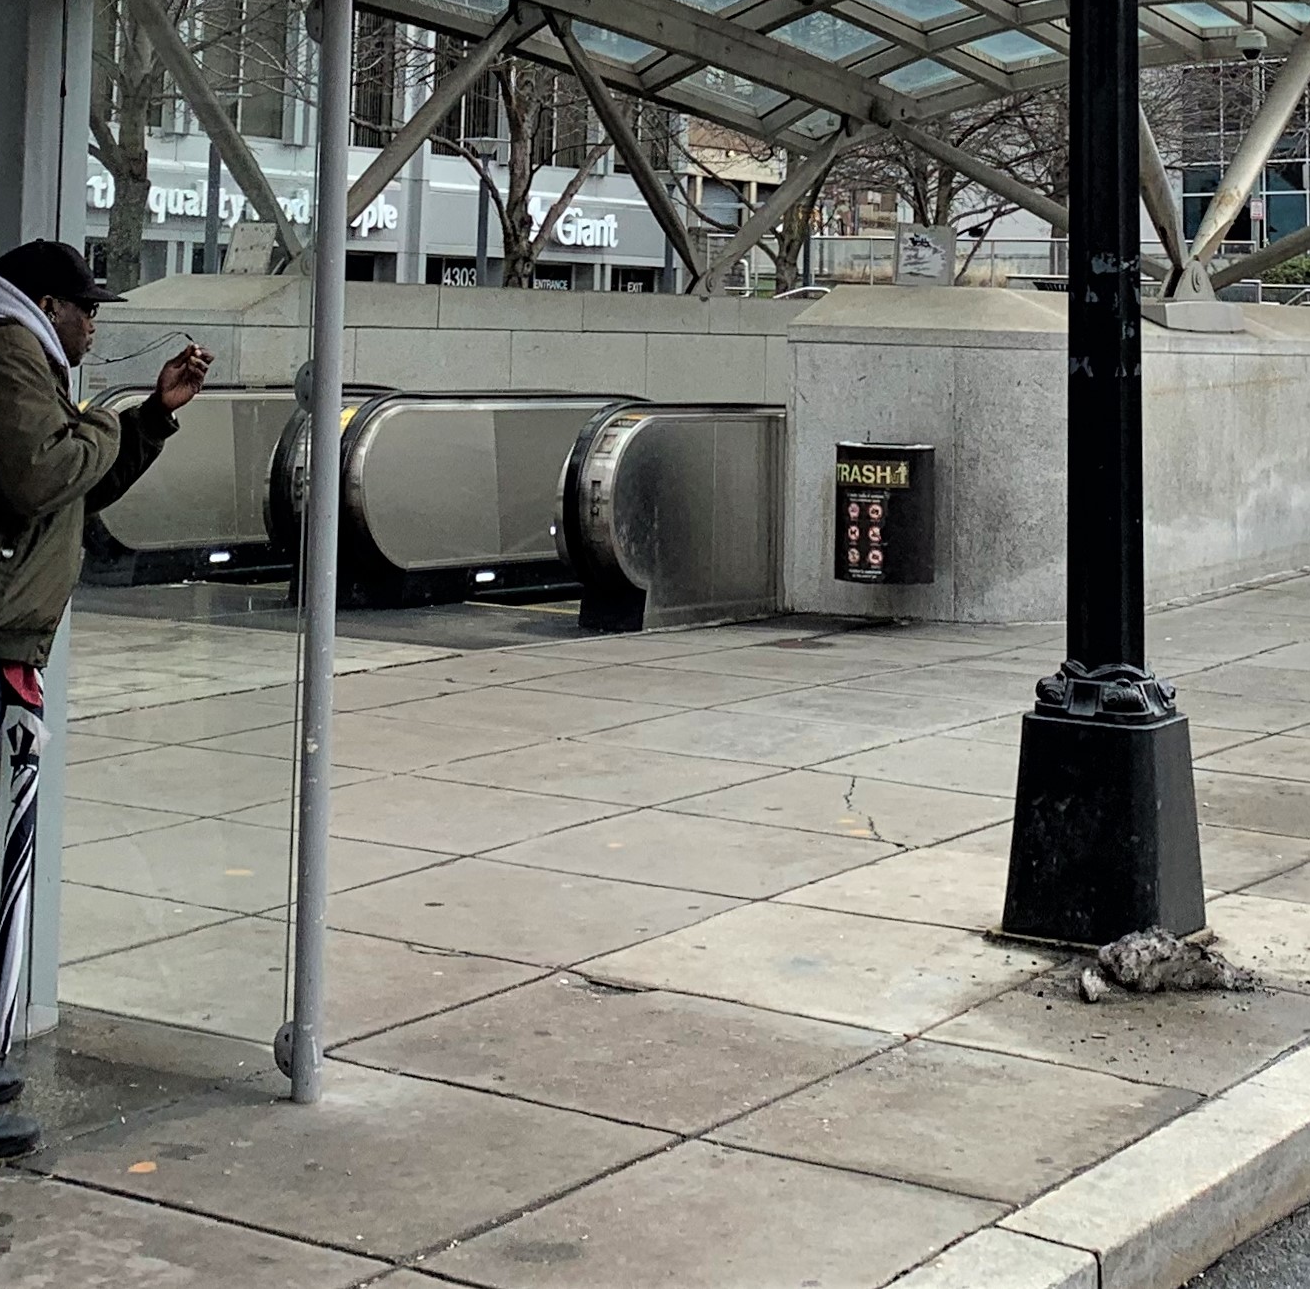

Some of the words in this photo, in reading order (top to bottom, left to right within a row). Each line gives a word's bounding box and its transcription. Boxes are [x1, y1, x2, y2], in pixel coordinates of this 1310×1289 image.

[149, 179, 247, 228] qualty
[556, 207, 618, 248] Giant
[444, 267, 477, 287] 4303
[534, 278, 568, 290] ENTRANCE
[627, 281, 643, 292] EXIT
[837, 464, 890, 484] TRASH
